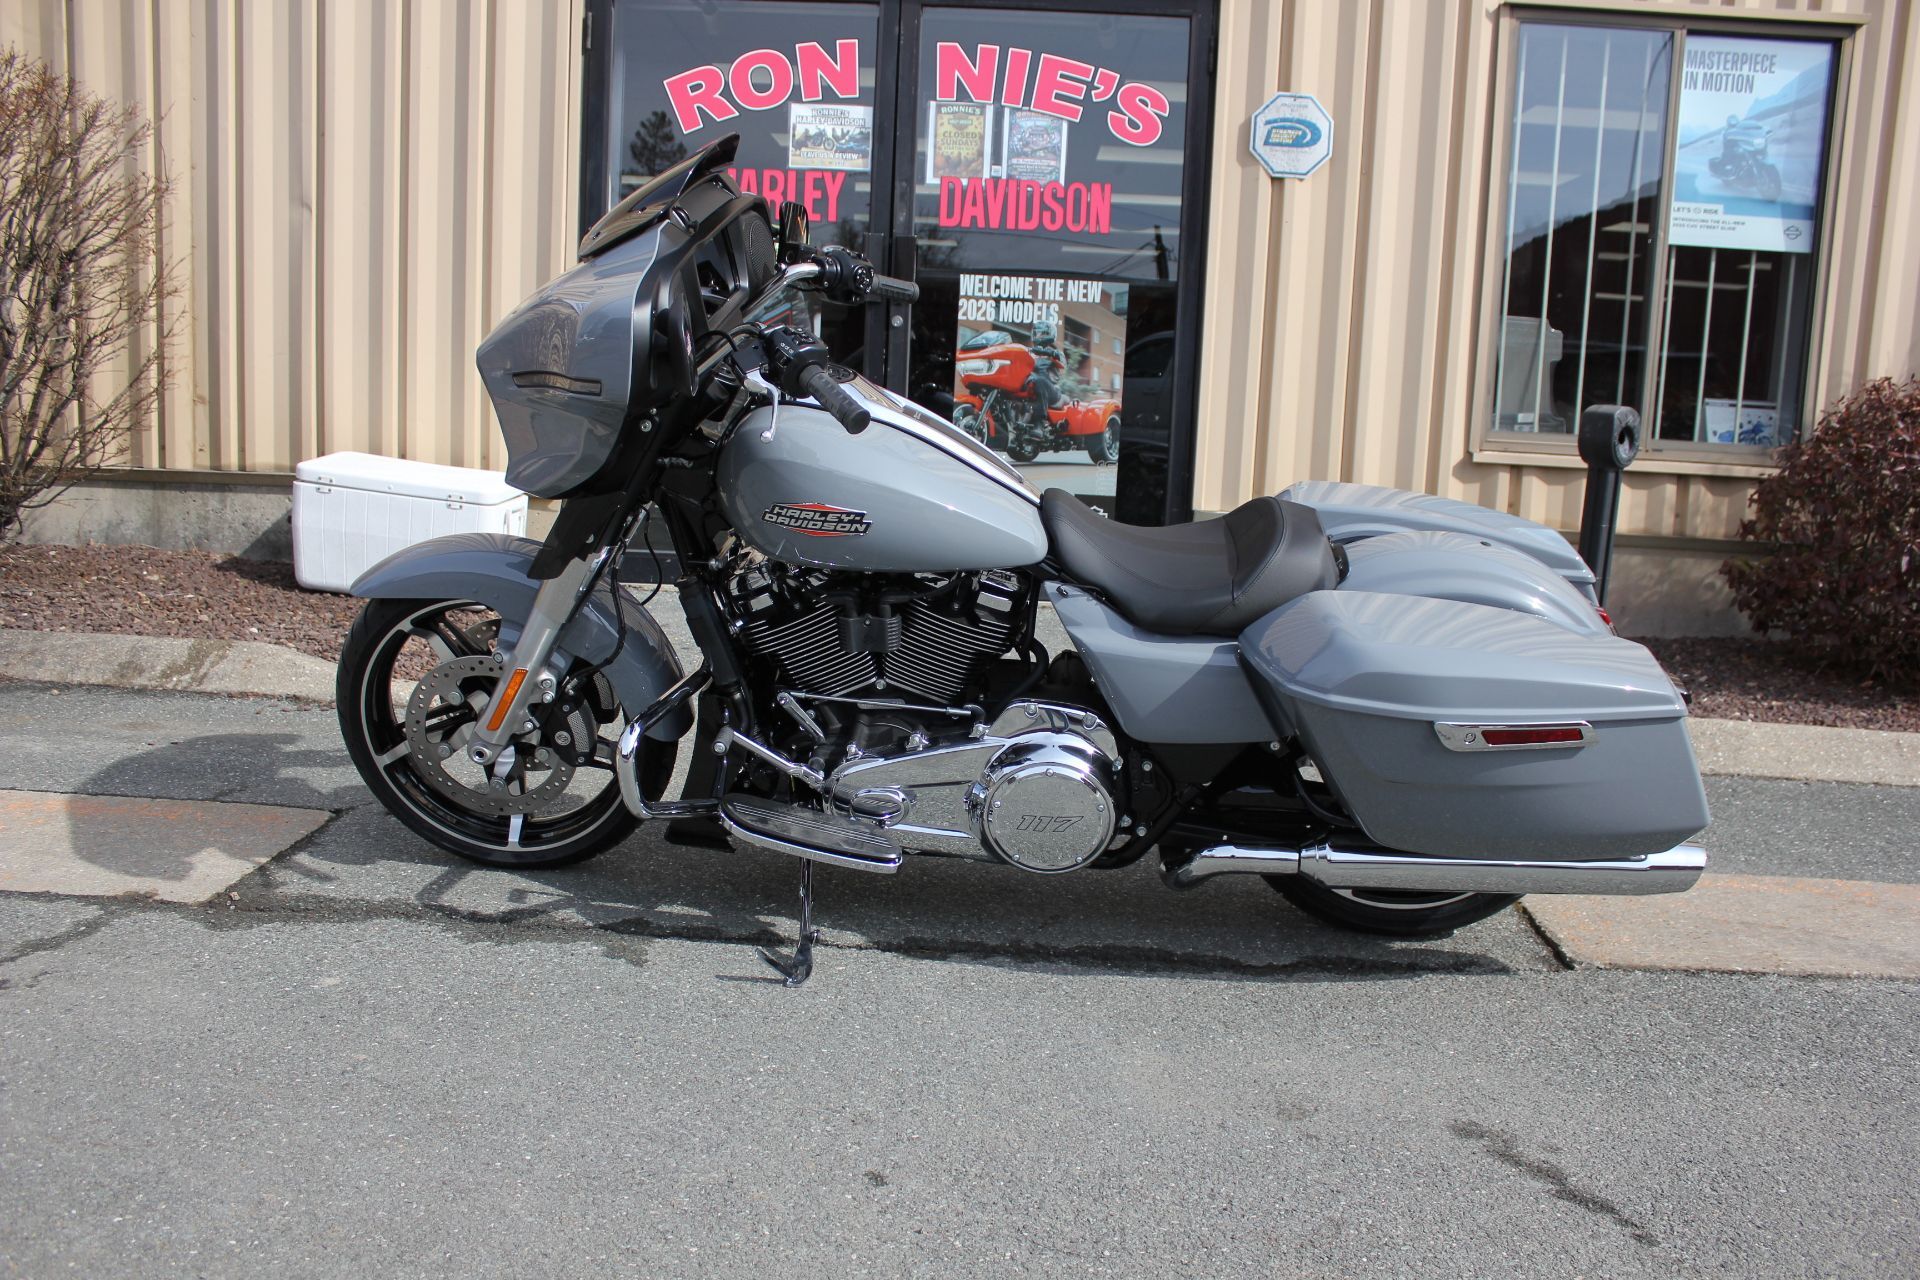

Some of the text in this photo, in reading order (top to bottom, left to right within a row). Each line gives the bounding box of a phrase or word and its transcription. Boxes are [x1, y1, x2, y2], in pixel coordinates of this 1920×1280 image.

[1685, 49, 1777, 75] MASTERPIECE
[662, 39, 1169, 147] RON NIE'S
[1683, 70, 1755, 95] IN MOTION
[940, 104, 981, 116] RONNIE'S
[940, 138, 980, 147] SUNDAYS
[942, 130, 978, 140] CLOSED
[727, 168, 1113, 234] ARLEY DAVIDSON
[959, 274, 1103, 304] WELCOME THE NEW
[957, 298, 996, 322] 2026
[764, 513, 867, 532] DAVIDSON
[773, 506, 861, 522] HARLEY-
[1016, 814, 1085, 832] 117
